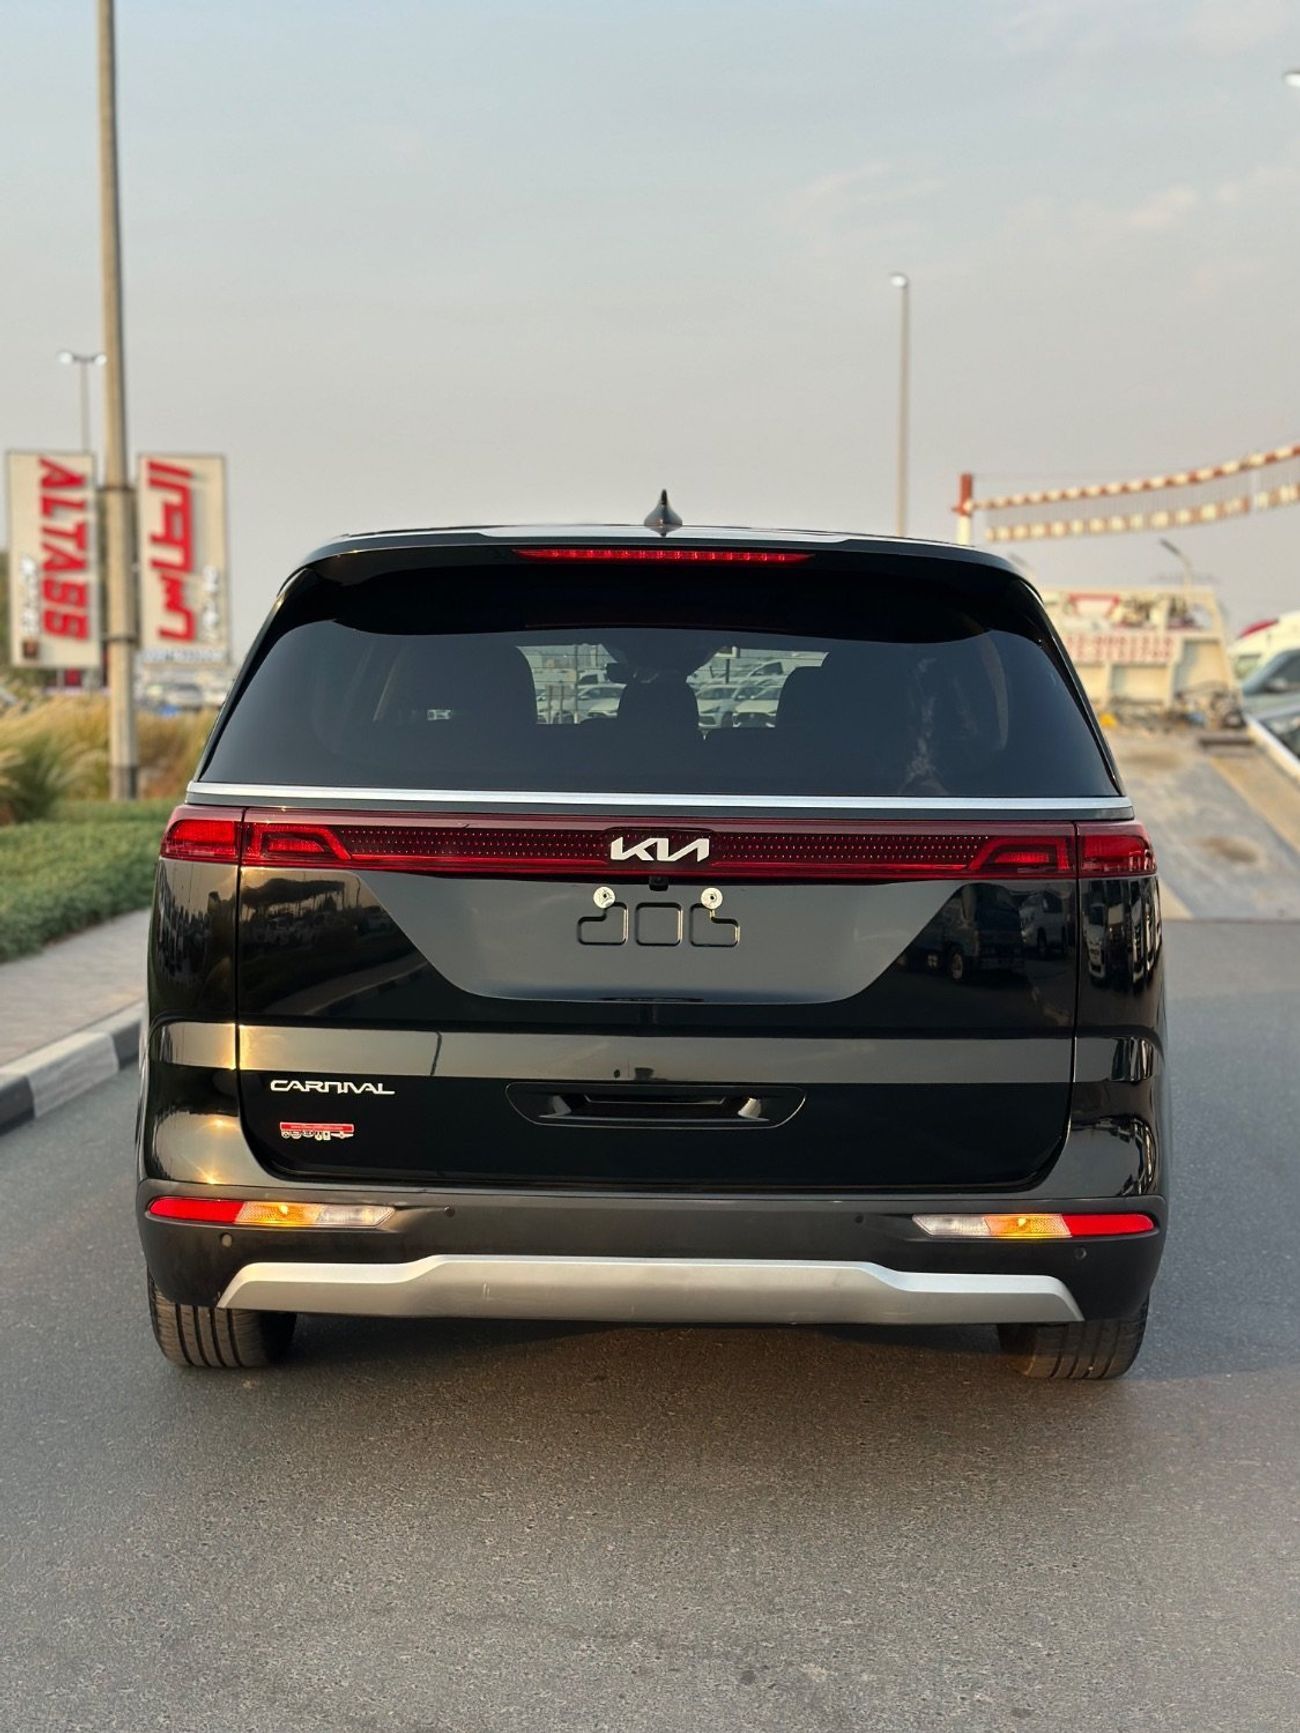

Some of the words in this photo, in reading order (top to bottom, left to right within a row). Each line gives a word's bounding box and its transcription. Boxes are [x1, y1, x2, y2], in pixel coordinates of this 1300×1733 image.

[38, 456, 89, 641] ALTASS
[610, 837, 710, 862] KIA
[270, 1080, 395, 1095] CARNIVAL
